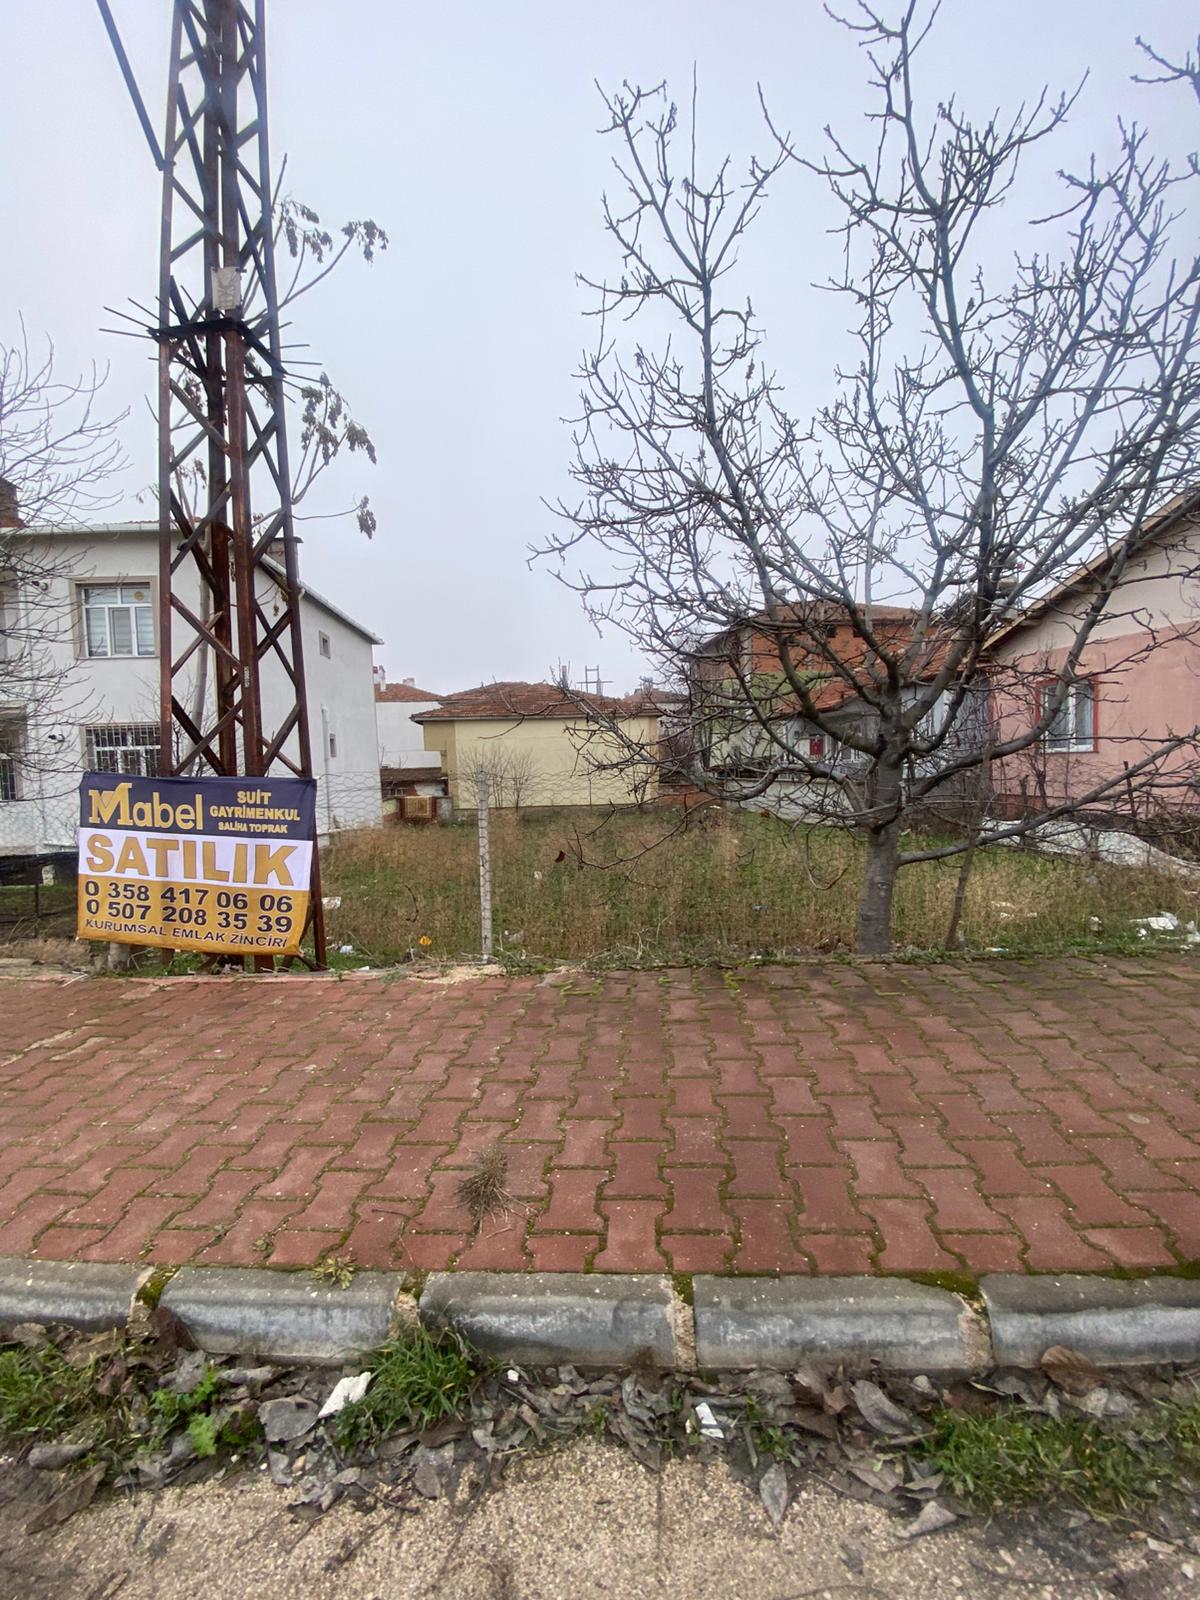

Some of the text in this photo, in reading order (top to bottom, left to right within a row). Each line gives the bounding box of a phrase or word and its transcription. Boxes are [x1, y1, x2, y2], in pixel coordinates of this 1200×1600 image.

[88, 782, 203, 830] Mabel
[236, 789, 272, 805] SUİT
[209, 804, 301, 821] GAYRİMENKUL
[218, 820, 288, 834] SALİHA TOPRAK
[86, 833, 299, 887] SATILIK
[85, 880, 293, 913] 0 358 417 06 06
[85, 918, 167, 936] KURUMSAL
[172, 927, 225, 942] EMLAK
[86, 899, 293, 933] 0 507 208 35 39
